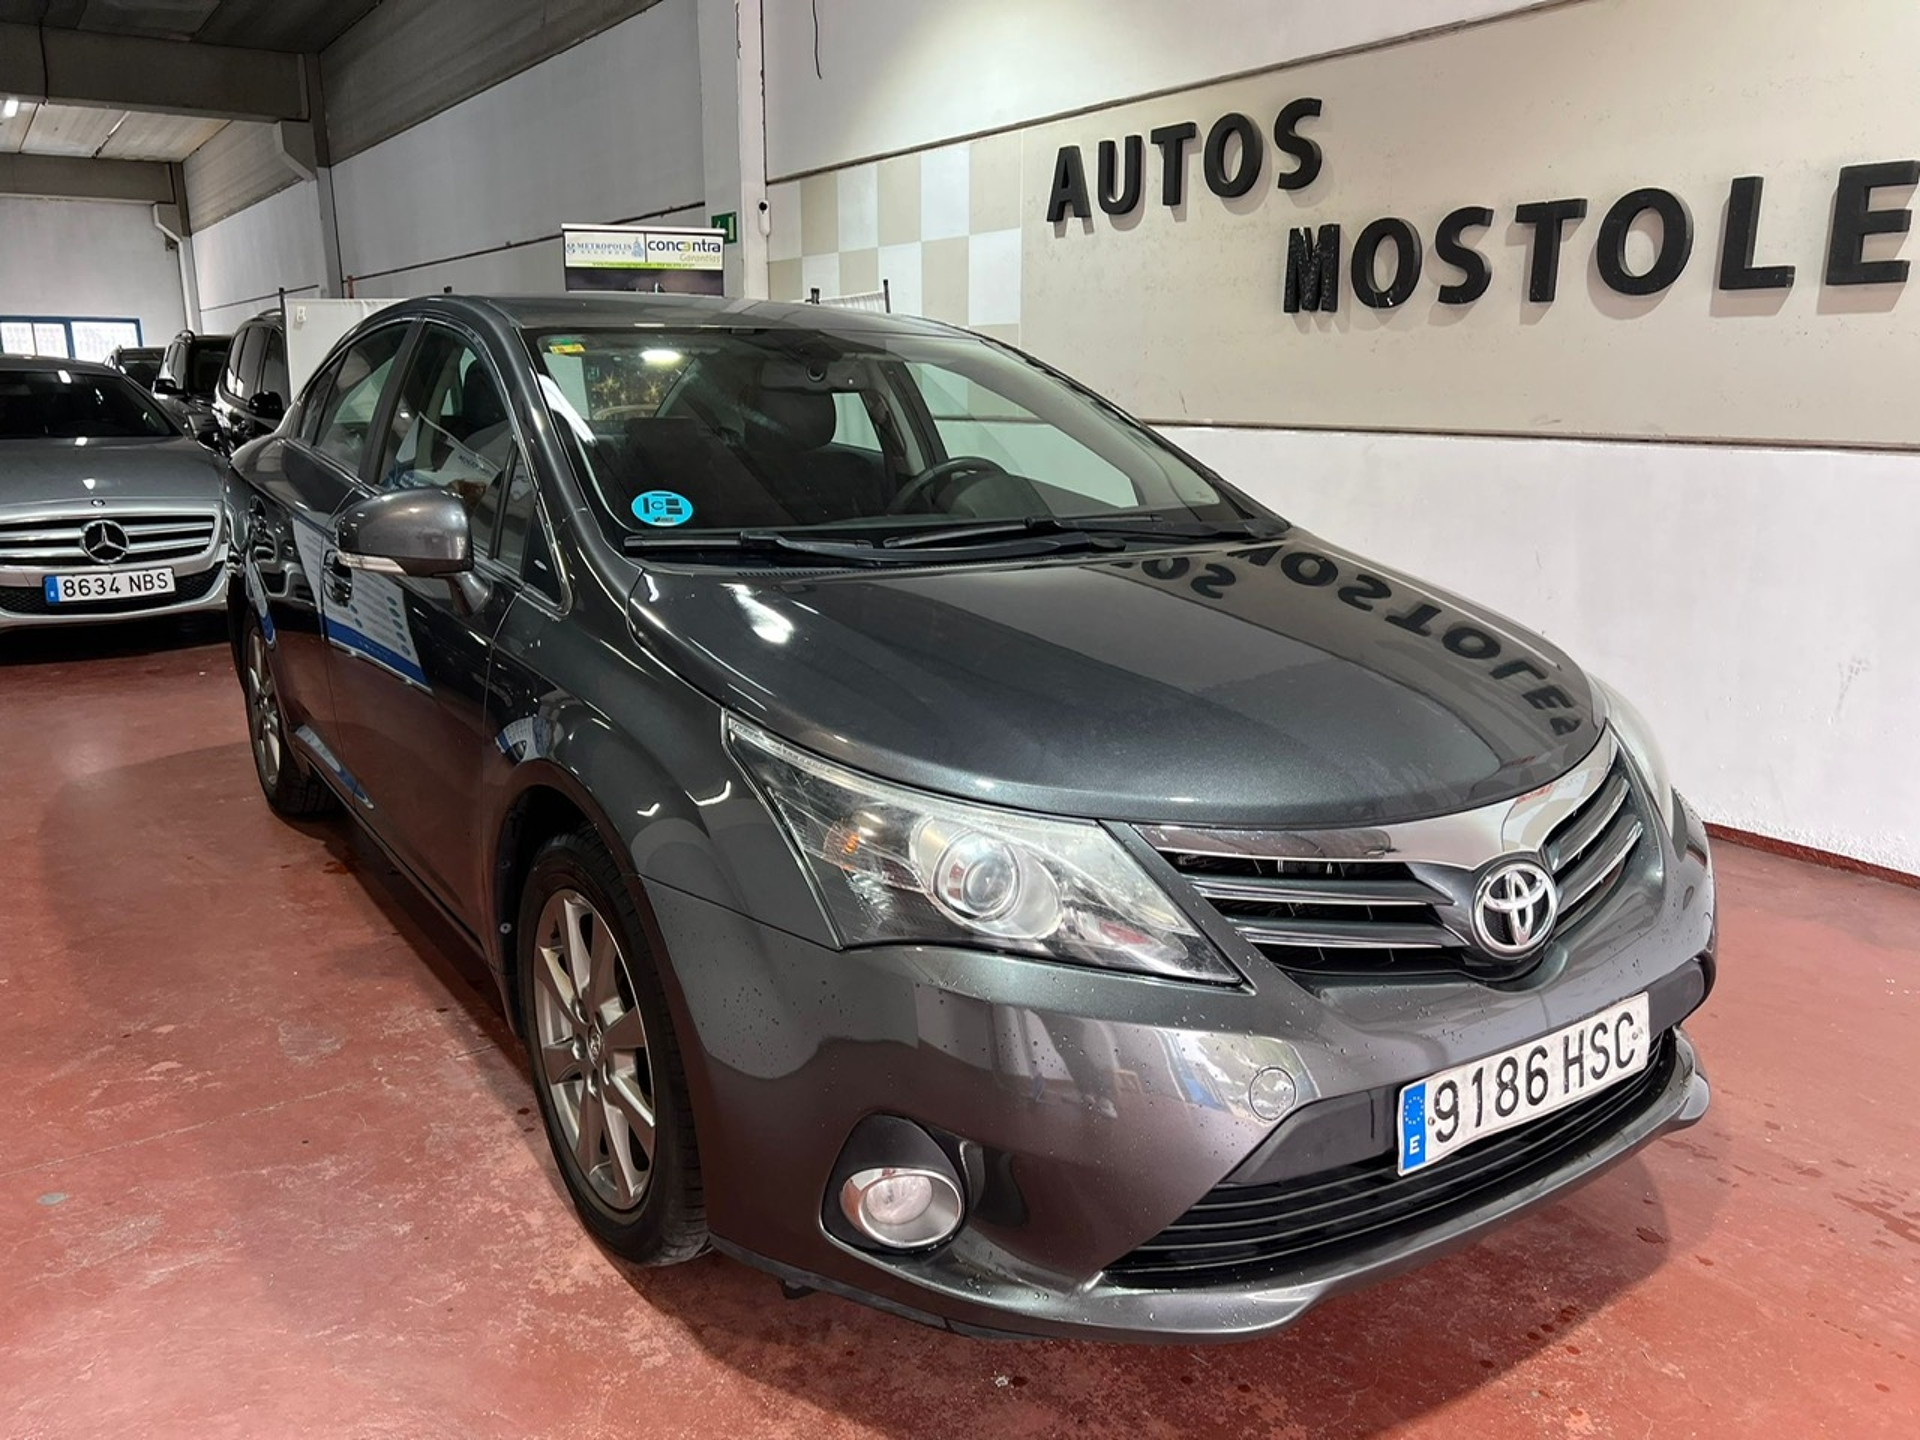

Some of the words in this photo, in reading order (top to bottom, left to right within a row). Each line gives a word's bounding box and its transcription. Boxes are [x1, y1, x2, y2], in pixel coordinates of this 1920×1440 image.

[1047, 97, 1323, 222] AUTOS
[647, 238, 721, 253] concentra
[1283, 160, 1920, 313] MOSTOLE
[63, 577, 121, 598] 8634
[128, 572, 168, 593] NBS
[1433, 1045, 1549, 1143] 9186
[1562, 1011, 1636, 1095] HSC
[1409, 1135, 1420, 1155] E
